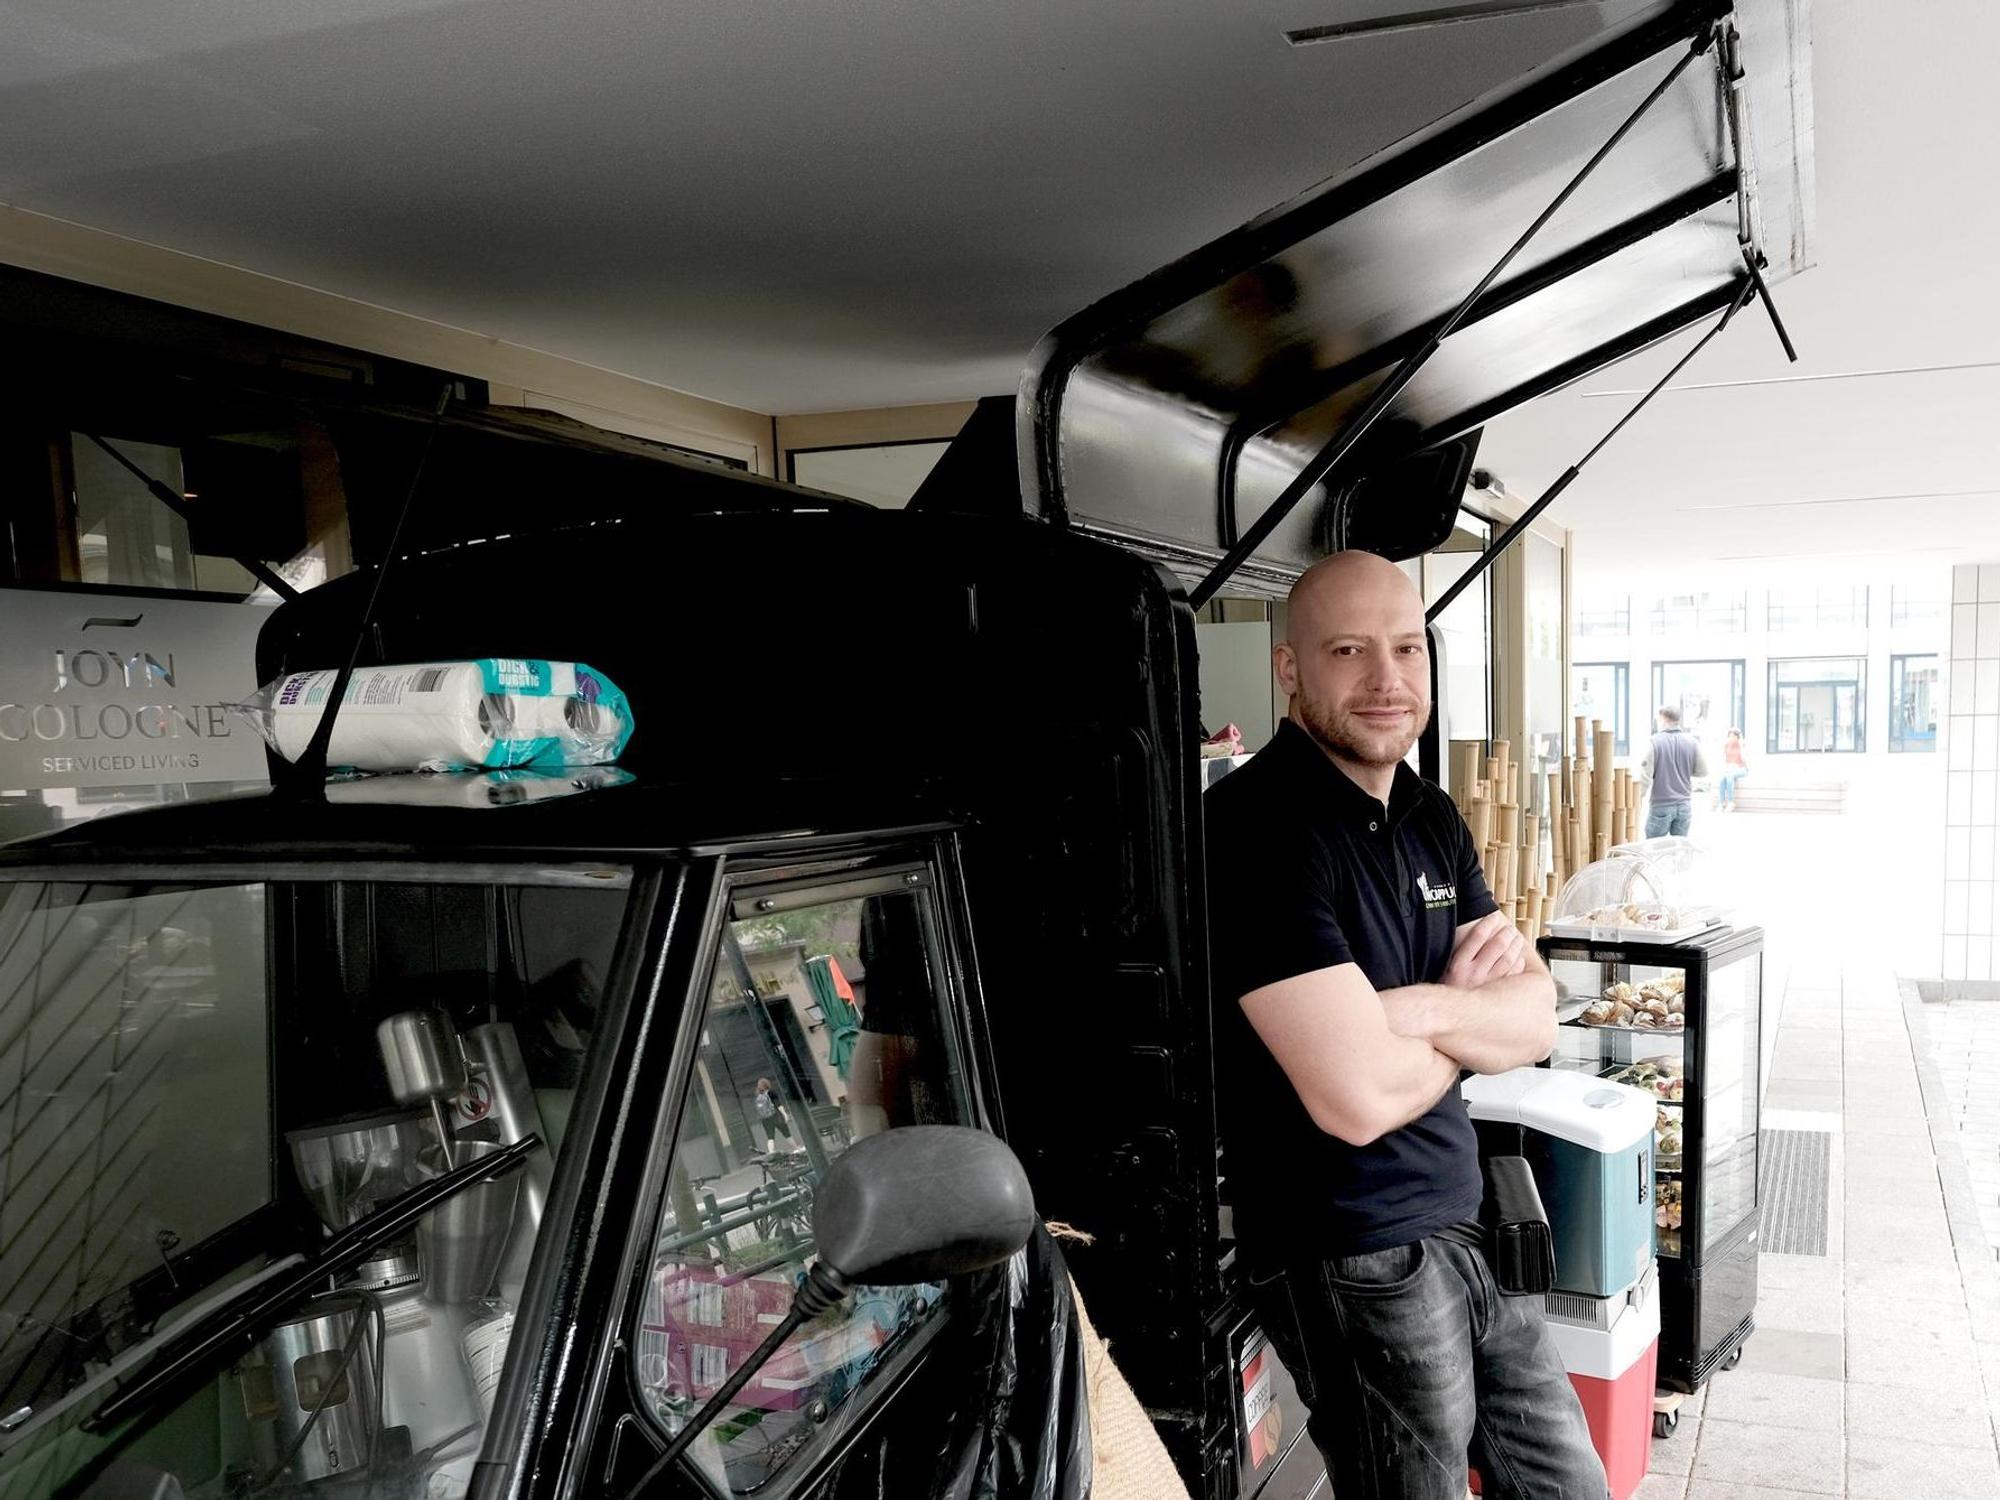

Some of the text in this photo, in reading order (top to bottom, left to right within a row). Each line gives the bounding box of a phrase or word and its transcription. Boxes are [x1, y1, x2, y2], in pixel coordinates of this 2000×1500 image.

[52, 650, 176, 693] JOYN
[279, 678, 300, 705] DICK
[0, 703, 231, 741] COLOGNE
[43, 754, 199, 773] SERVICED LIVING
